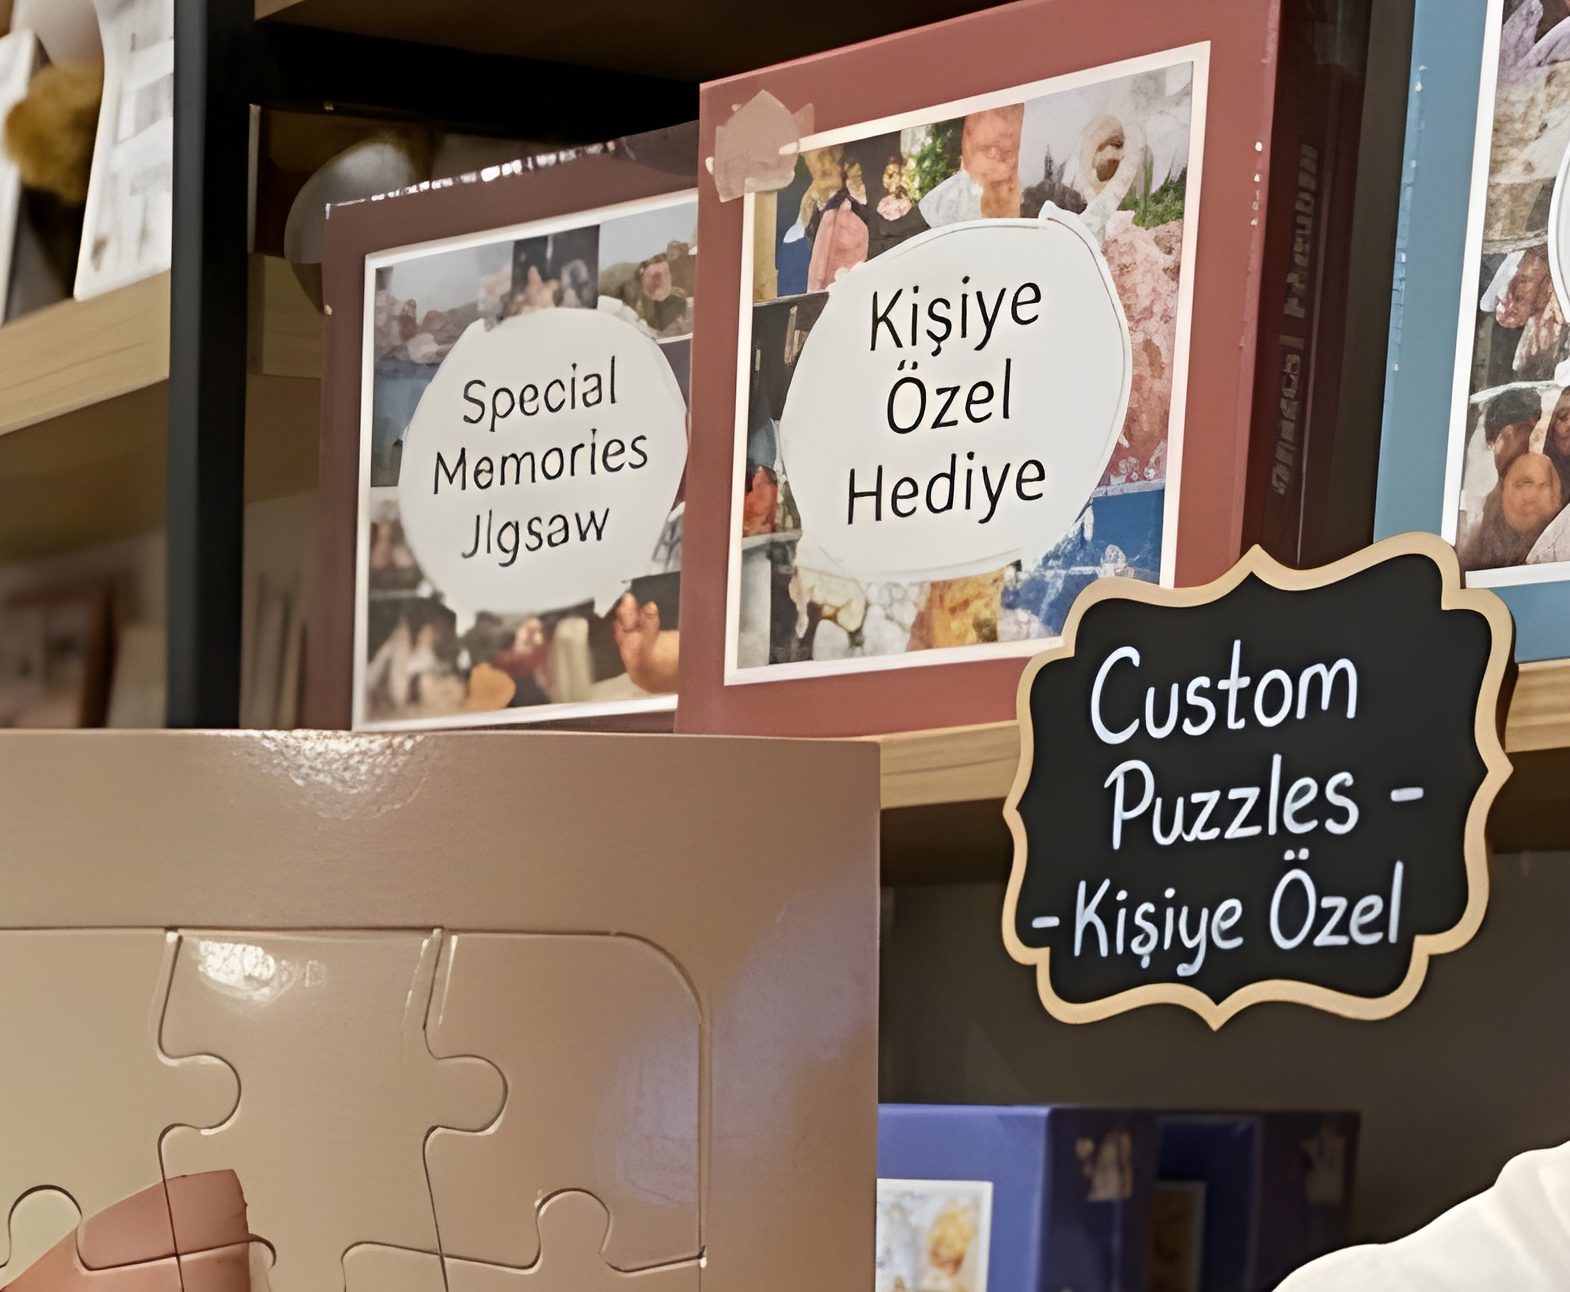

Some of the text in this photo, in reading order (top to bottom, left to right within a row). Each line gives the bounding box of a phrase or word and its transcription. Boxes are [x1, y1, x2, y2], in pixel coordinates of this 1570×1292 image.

[870, 275, 1042, 357] Kişiye
[462, 355, 617, 433] Special
[887, 358, 1012, 435] Özel
[433, 428, 649, 495] Memories
[847, 451, 1046, 525] Hediye
[1090, 639, 1358, 745] Custom
[1103, 753, 1360, 850] Puzzles
[1269, 847, 1404, 950] Özel
